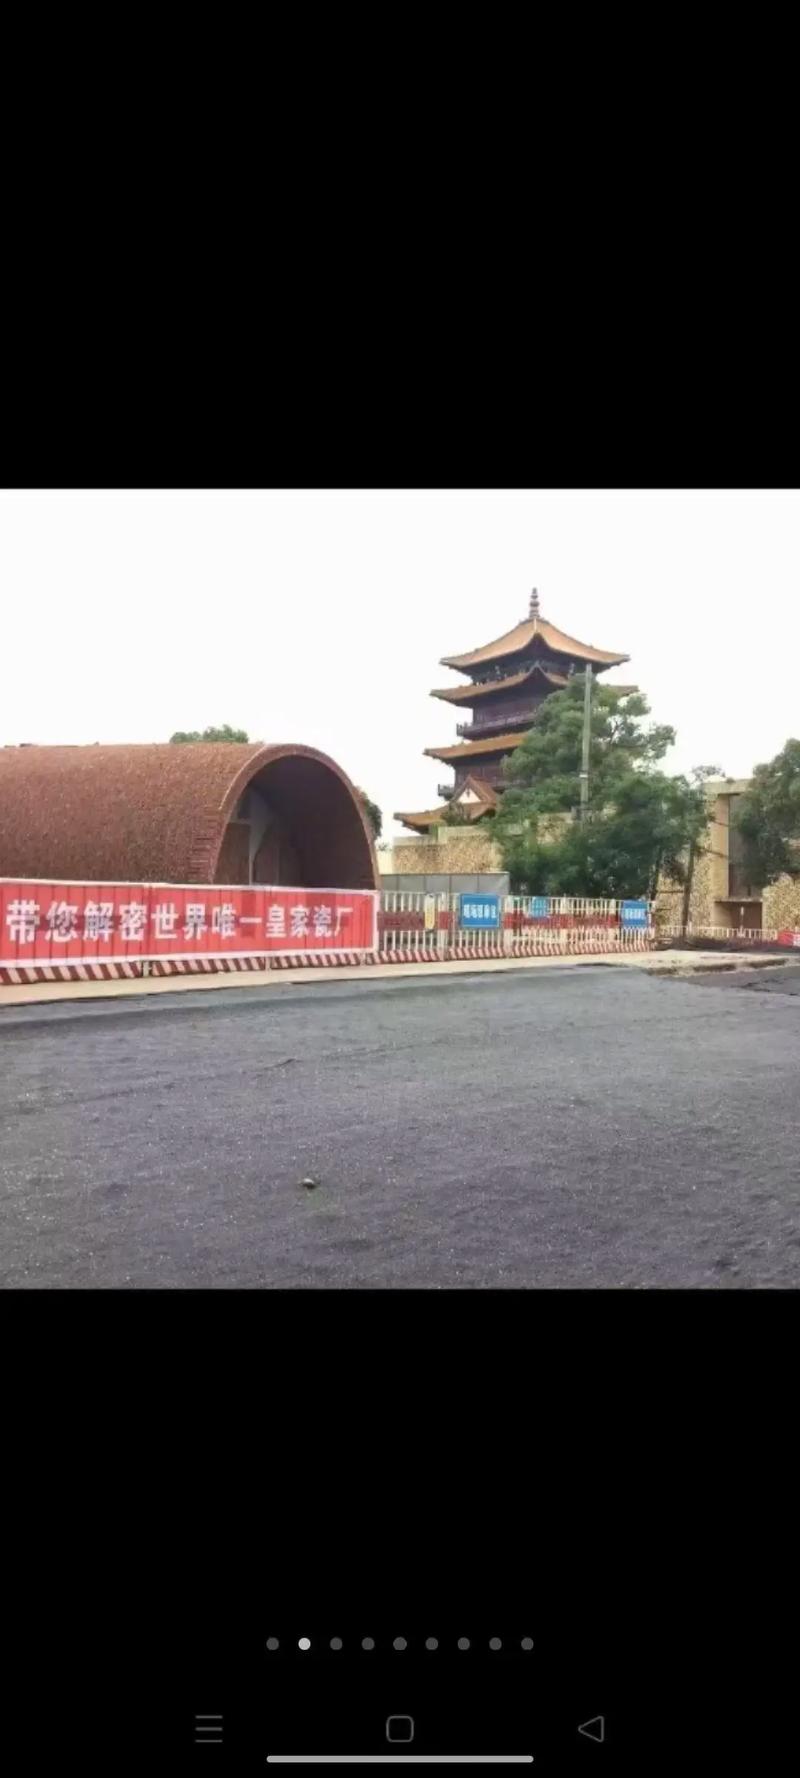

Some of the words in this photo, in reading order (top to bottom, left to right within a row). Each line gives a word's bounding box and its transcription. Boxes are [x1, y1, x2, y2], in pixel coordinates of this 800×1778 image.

[7, 899, 353, 943] 带您解密世界唯一皇家瓷厂
